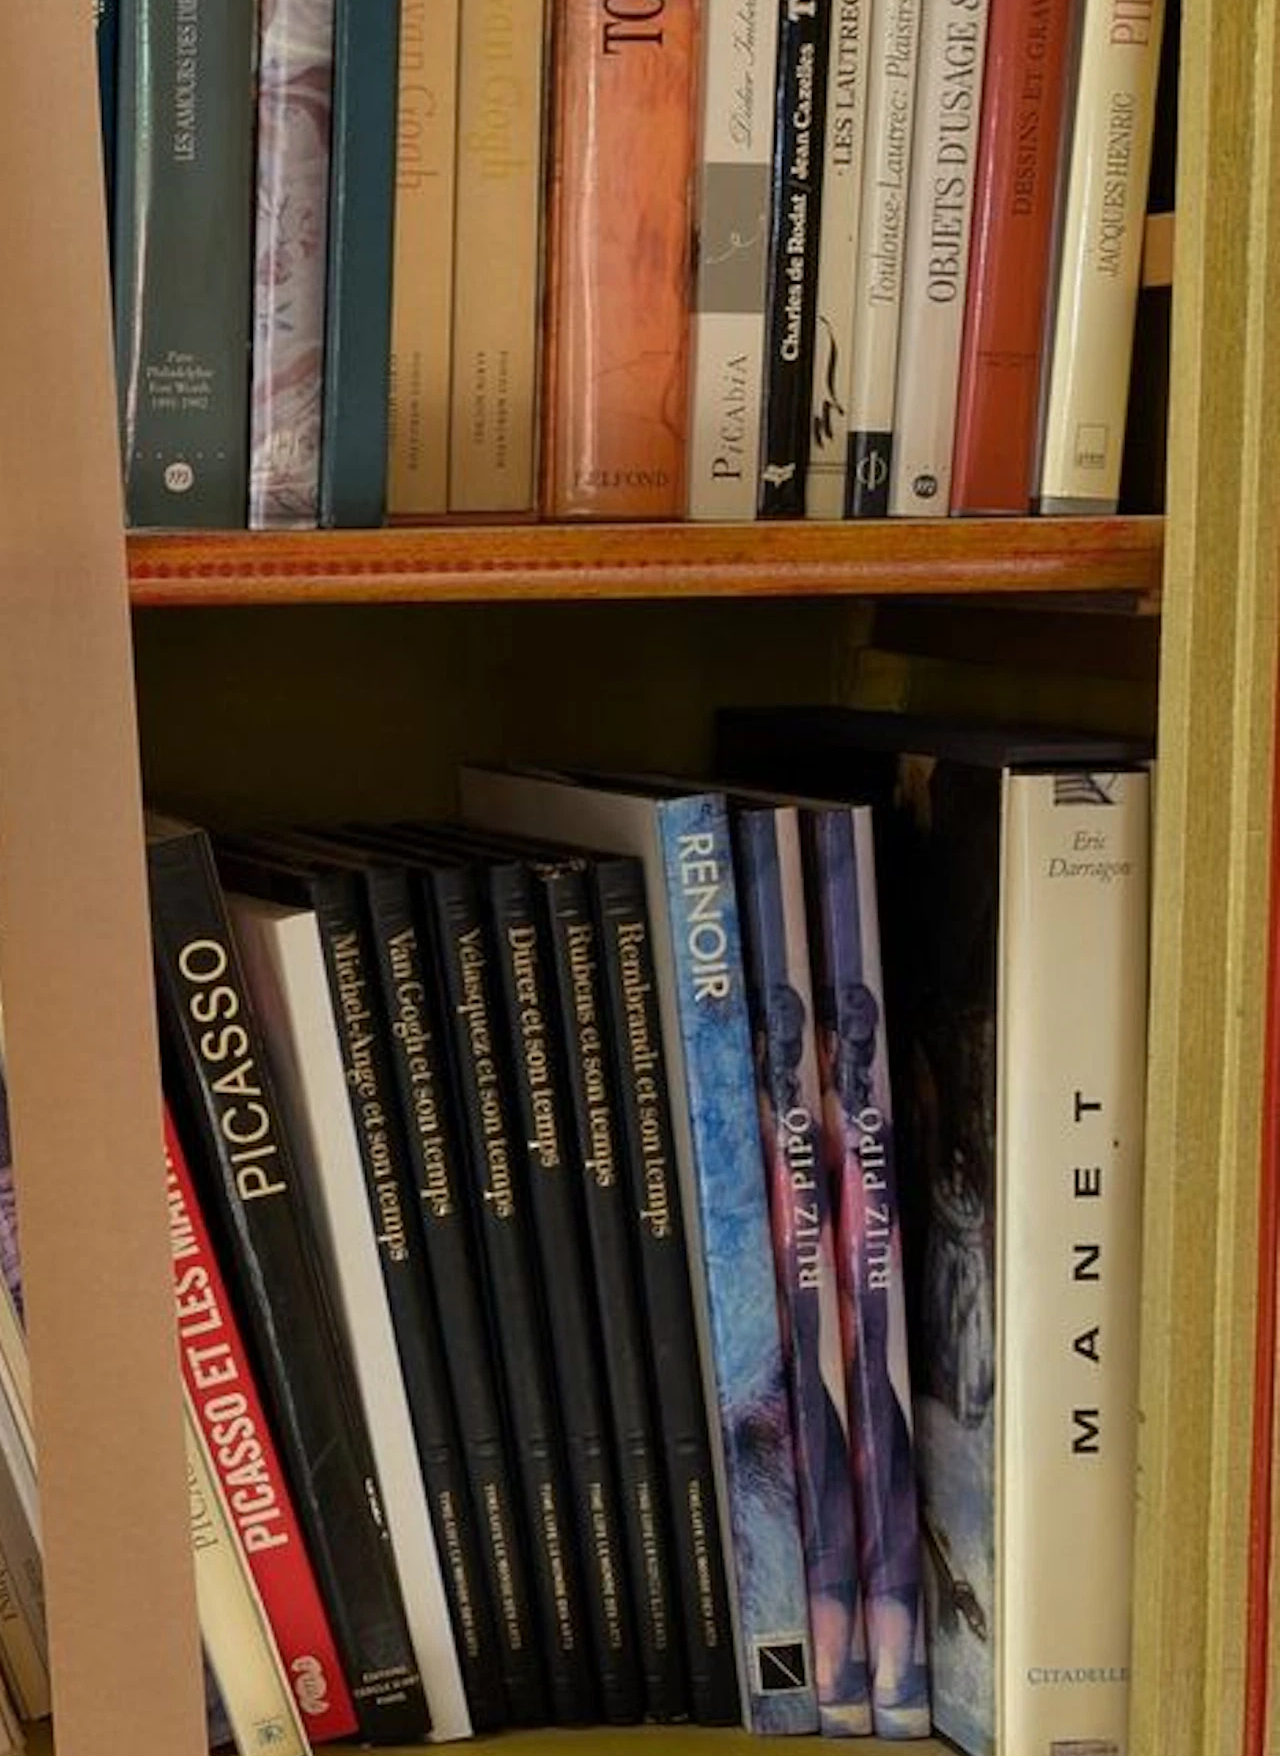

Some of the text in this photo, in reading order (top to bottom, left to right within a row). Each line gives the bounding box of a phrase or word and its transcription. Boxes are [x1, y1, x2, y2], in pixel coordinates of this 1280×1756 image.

[779, 43, 817, 362] Charles Rodat Cazelles
[928, 162, 967, 304] OBJETS
[677, 831, 730, 1004] RENOIR
[179, 938, 287, 1202] PICASSO
[331, 932, 377, 1098] Michel-Ange
[1071, 1091, 1104, 1456] MANET
[203, 1390, 289, 1555] PICASSO
